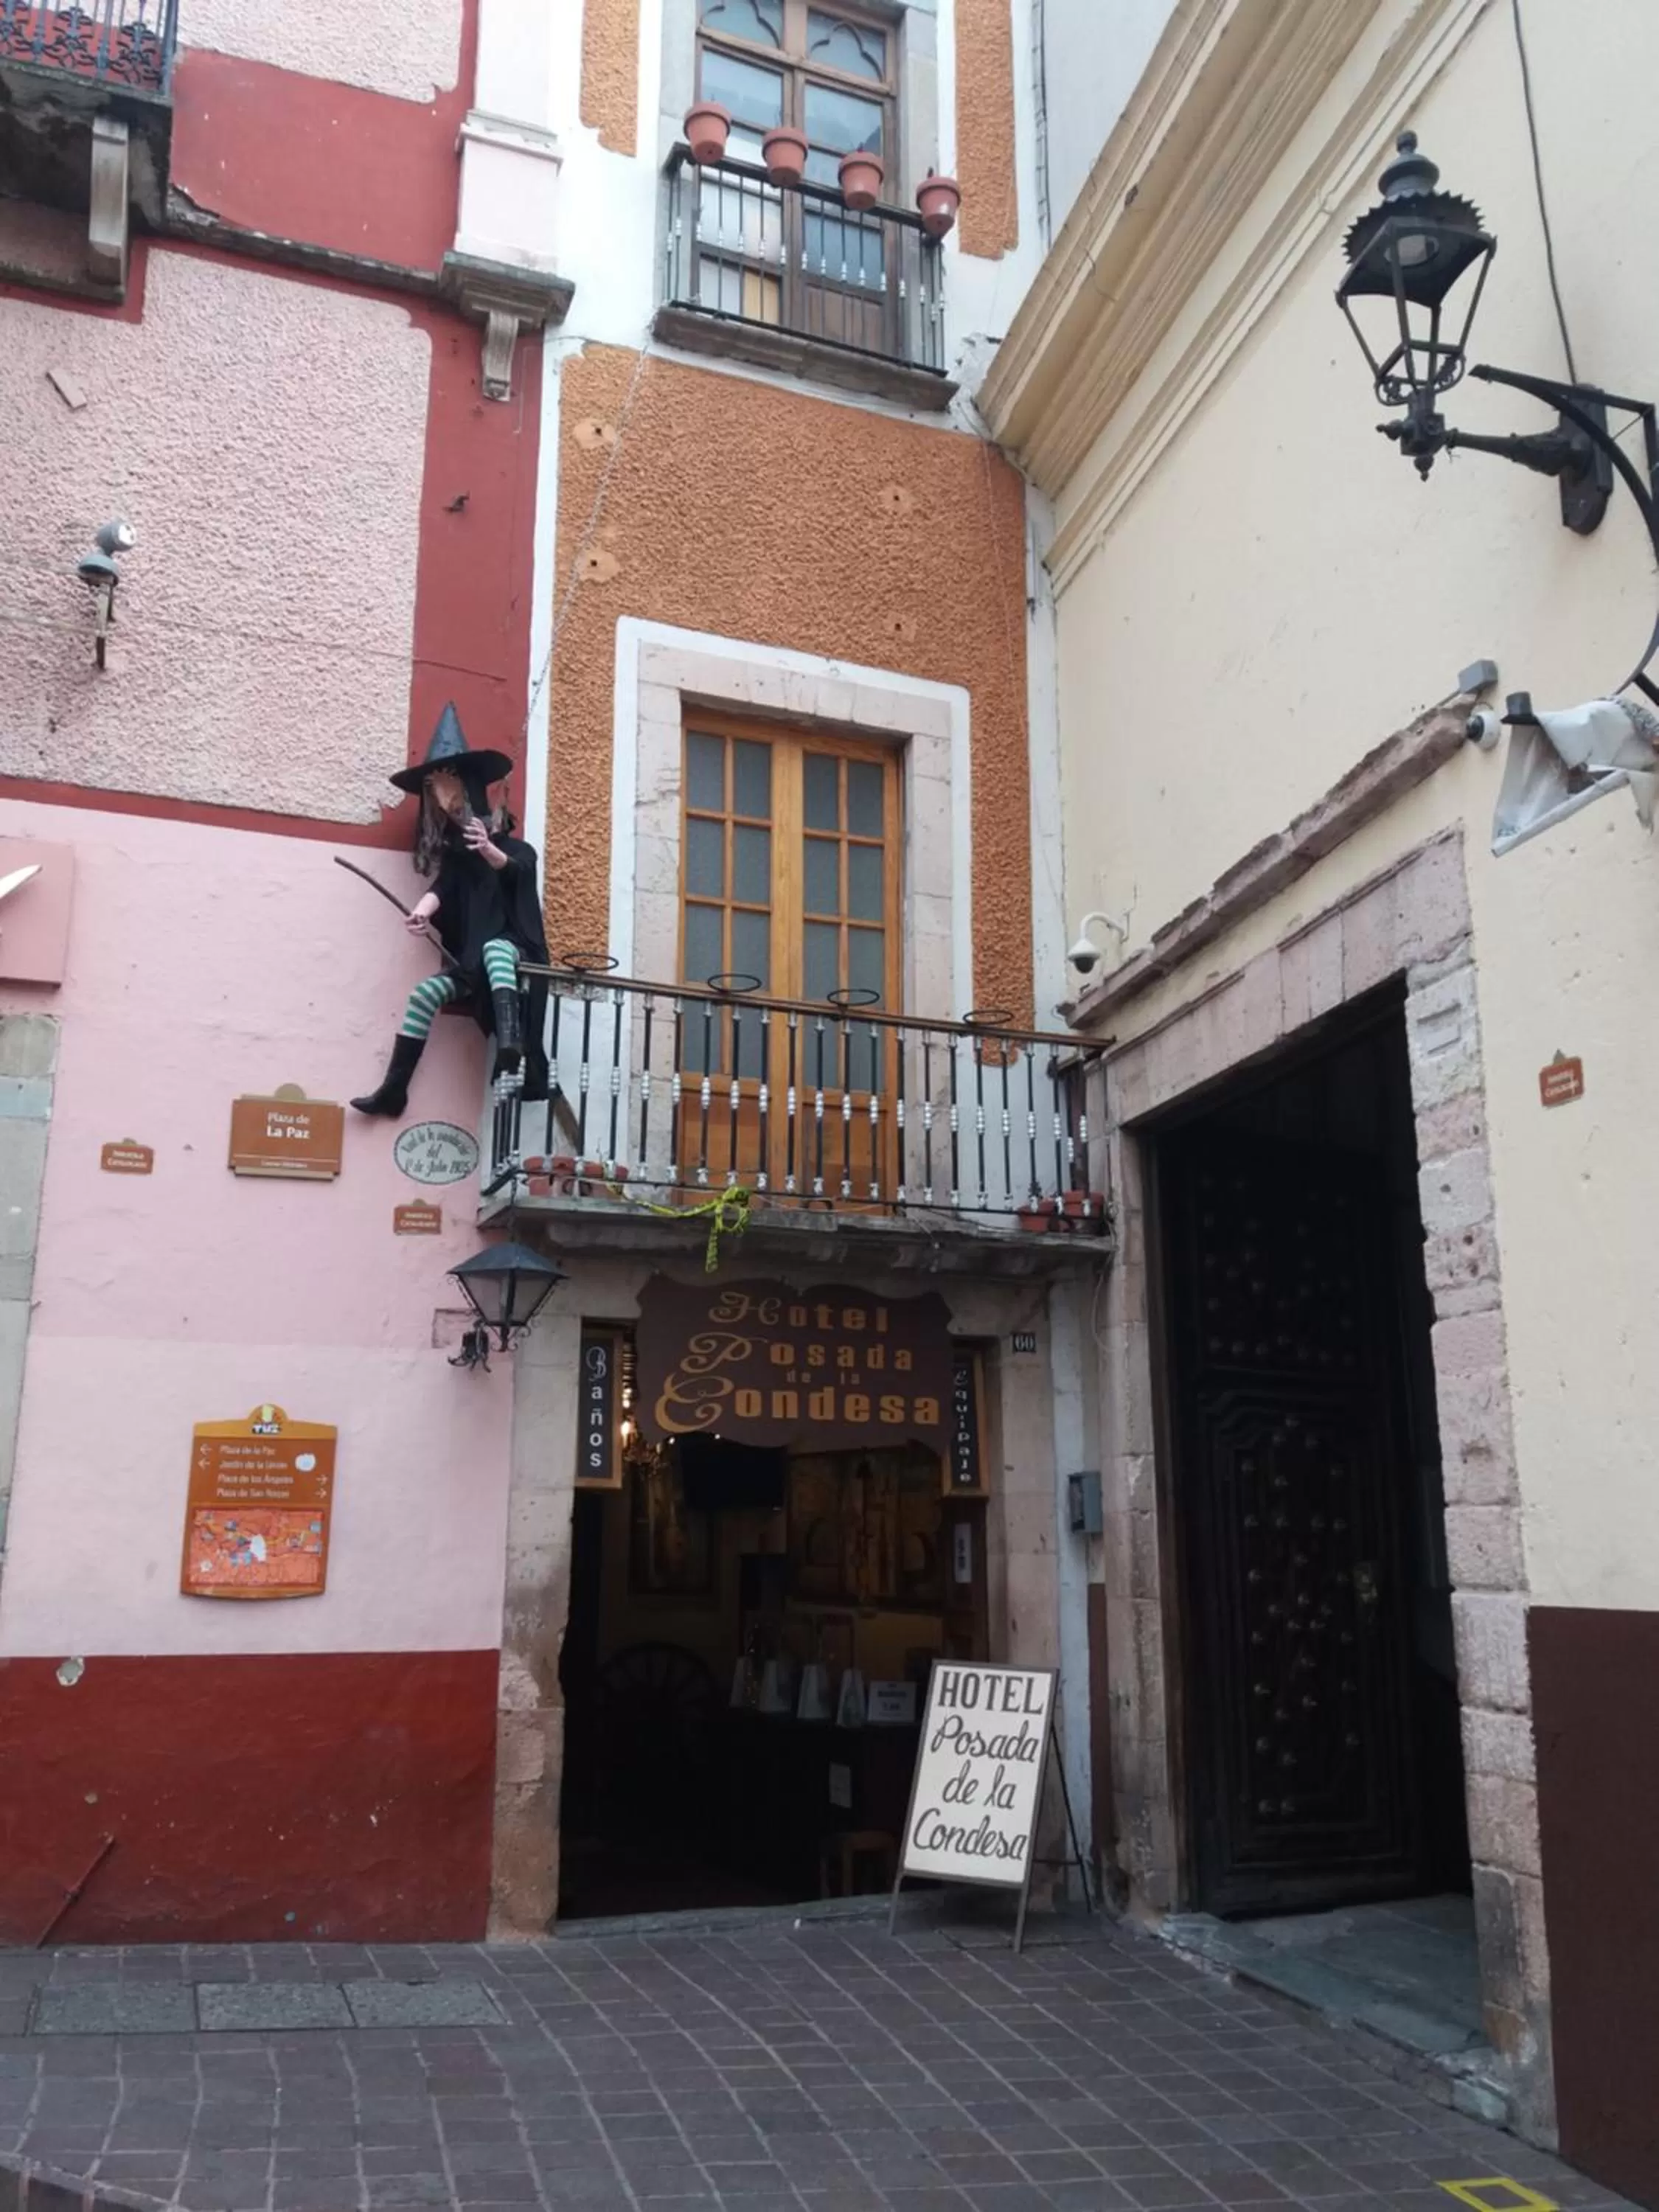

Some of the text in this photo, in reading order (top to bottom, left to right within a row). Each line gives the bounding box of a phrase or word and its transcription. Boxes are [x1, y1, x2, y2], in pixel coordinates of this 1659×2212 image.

[266, 1124, 310, 1139] La Paz
[268, 1112, 310, 1124] Plaza de
[709, 1291, 888, 1332] Hotel
[680, 1332, 912, 1374] Posada
[786, 1369, 860, 1385] de la
[586, 1346, 607, 1467] Baños
[655, 1373, 939, 1433] Condesa
[937, 1670, 1044, 1715] HOTEL
[931, 1714, 1039, 1764] Posada
[942, 1759, 1016, 1810] de la
[913, 1807, 1028, 1862] Condesa
